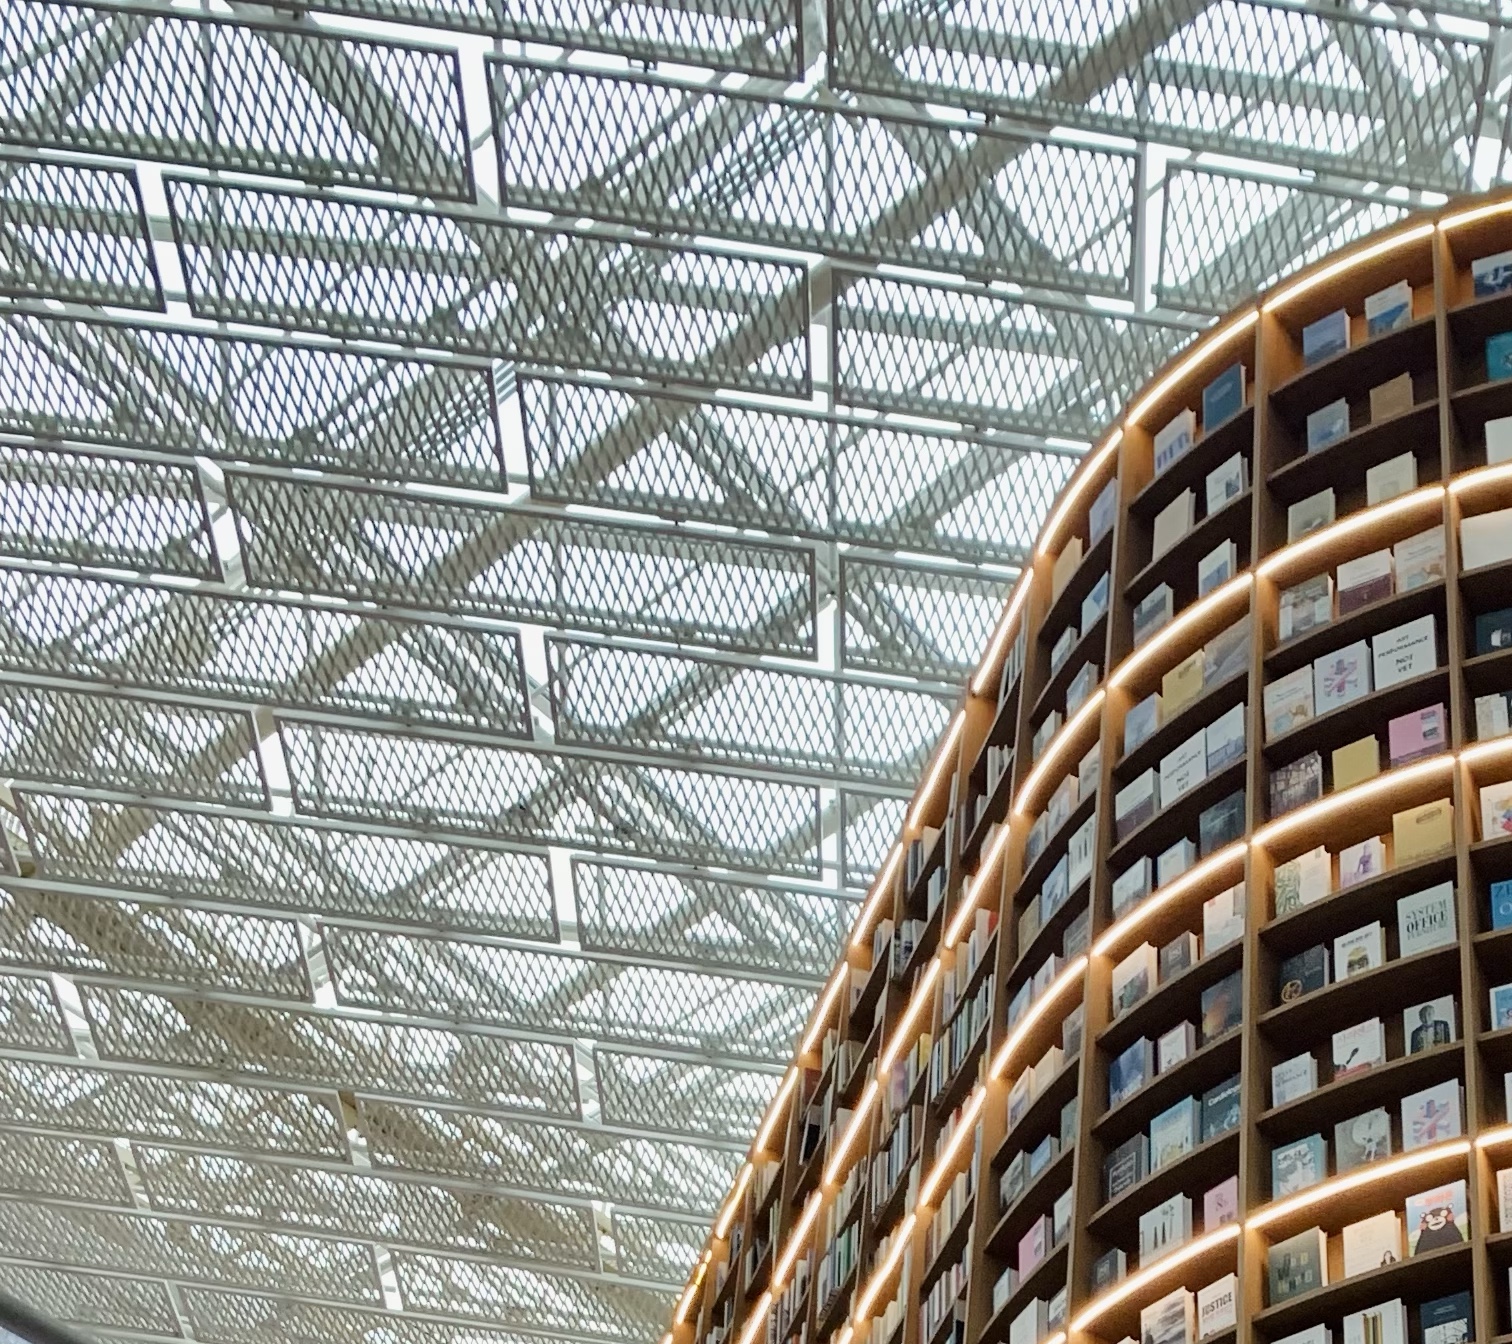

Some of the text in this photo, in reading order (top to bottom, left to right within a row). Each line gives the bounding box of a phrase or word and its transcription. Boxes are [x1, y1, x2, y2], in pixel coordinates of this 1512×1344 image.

[1405, 898, 1448, 920] SYSTEM
[1406, 910, 1446, 934] OFFICE
[1201, 1291, 1232, 1318] JUSTICE
